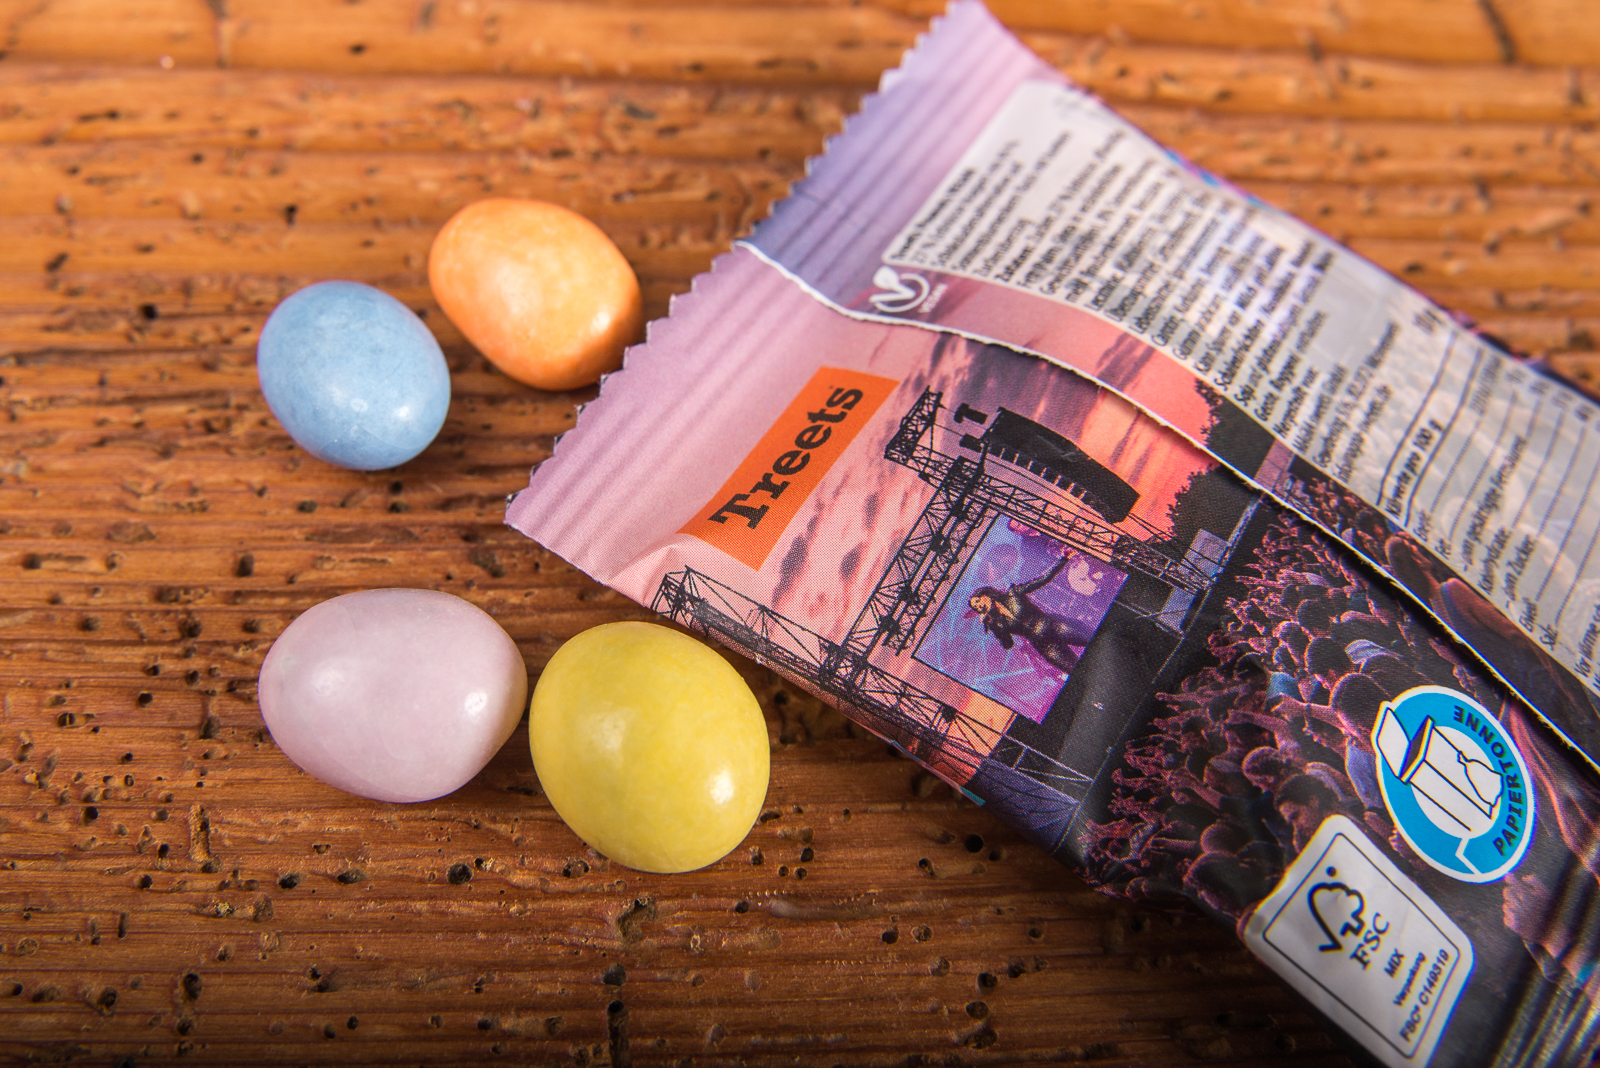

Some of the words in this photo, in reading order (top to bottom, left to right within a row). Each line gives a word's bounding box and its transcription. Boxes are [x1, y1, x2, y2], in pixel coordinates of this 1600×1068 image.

[708, 387, 864, 530] Treets
[1403, 451, 1421, 475] pro
[1412, 426, 1434, 452] 100
[1574, 656, 1593, 678] Vor
[1453, 705, 1524, 856] PAPIERTONNE
[1349, 912, 1391, 971] FSC
[1384, 948, 1405, 978] MIX
